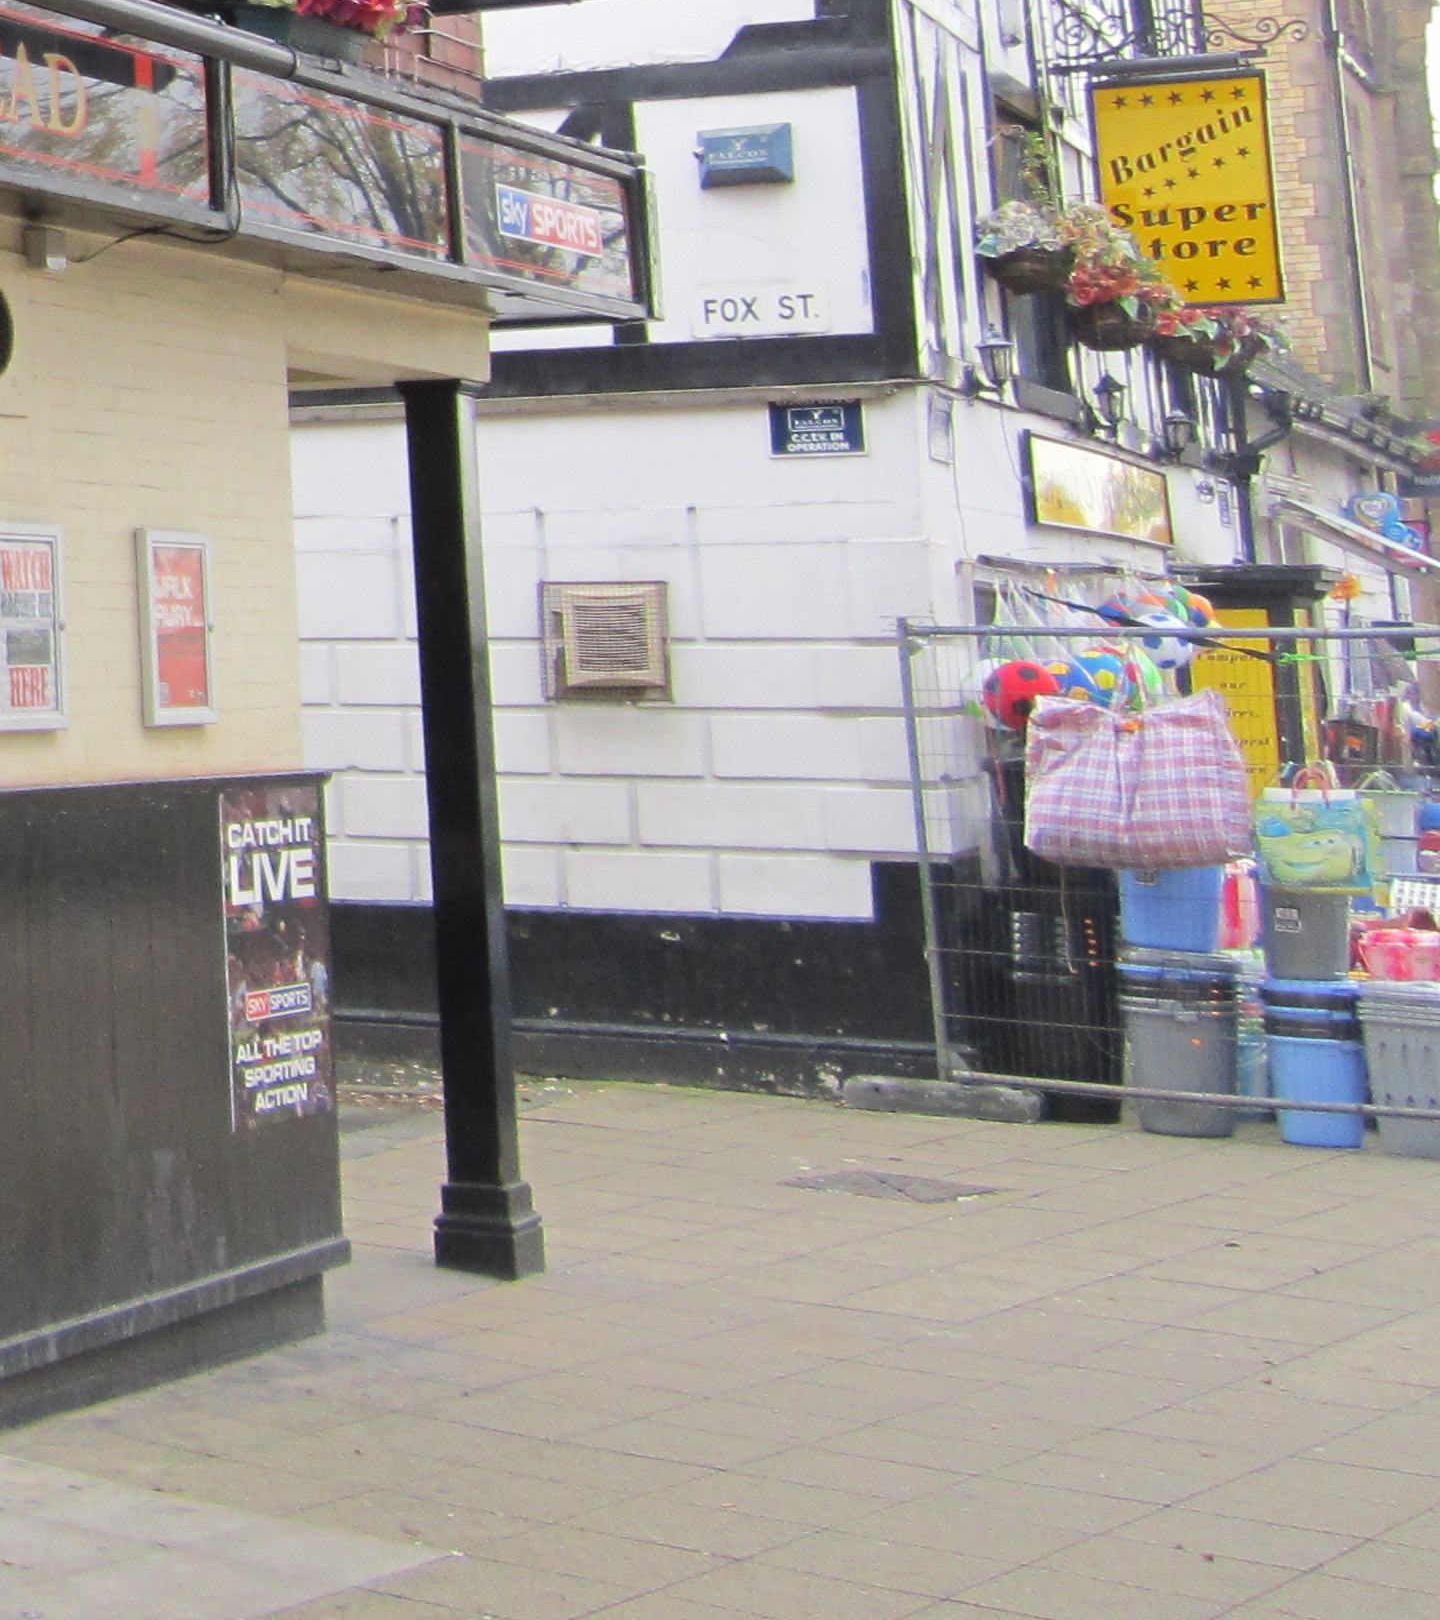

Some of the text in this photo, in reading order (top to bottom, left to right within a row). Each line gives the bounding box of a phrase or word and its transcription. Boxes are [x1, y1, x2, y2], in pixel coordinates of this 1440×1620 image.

[1109, 105, 1254, 186] Bargain
[532, 203, 598, 248] SPORTS
[1110, 201, 1266, 231] Super
[1148, 236, 1257, 261] tore
[703, 296, 760, 324] FOX
[786, 442, 851, 452] OPERATION
[9, 667, 48, 708] HERE
[227, 816, 312, 849] CATCH IT
[229, 847, 317, 906] LIVE
[247, 987, 310, 1018] SKY SPORTS
[235, 1030, 322, 1065] ALL THE TOP
[245, 1056, 316, 1088] SPORTING
[255, 1083, 308, 1113] ACTION
